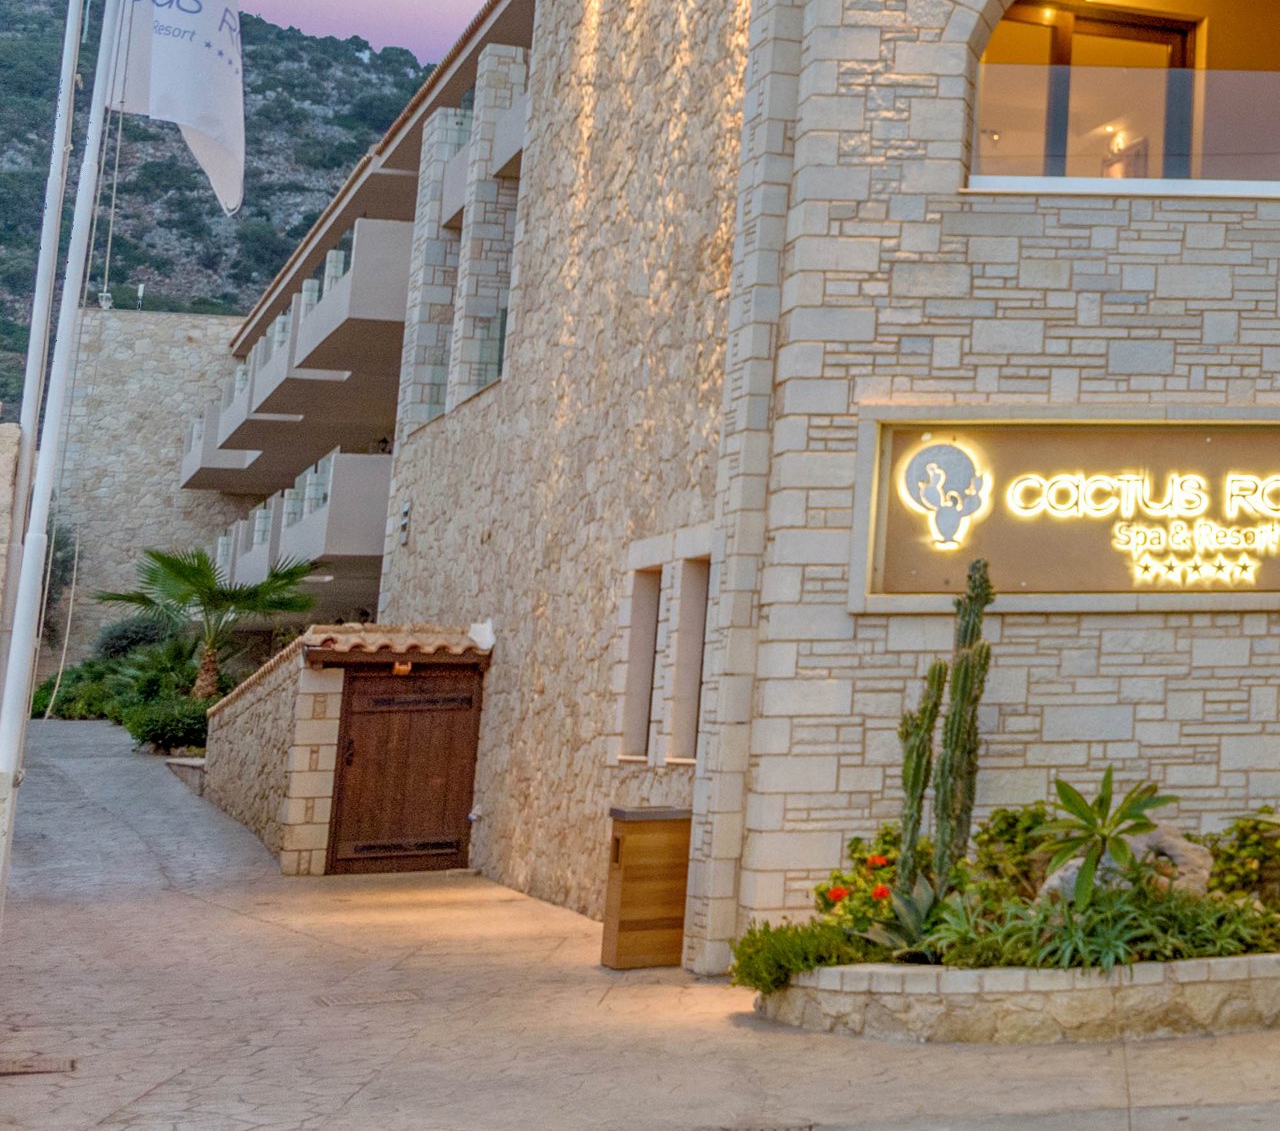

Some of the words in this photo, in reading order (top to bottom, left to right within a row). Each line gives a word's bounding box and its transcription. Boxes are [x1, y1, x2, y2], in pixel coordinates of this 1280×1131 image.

[1114, 521, 1162, 556] Spa
[1168, 521, 1192, 549] &
[1195, 521, 1280, 554] Resort
